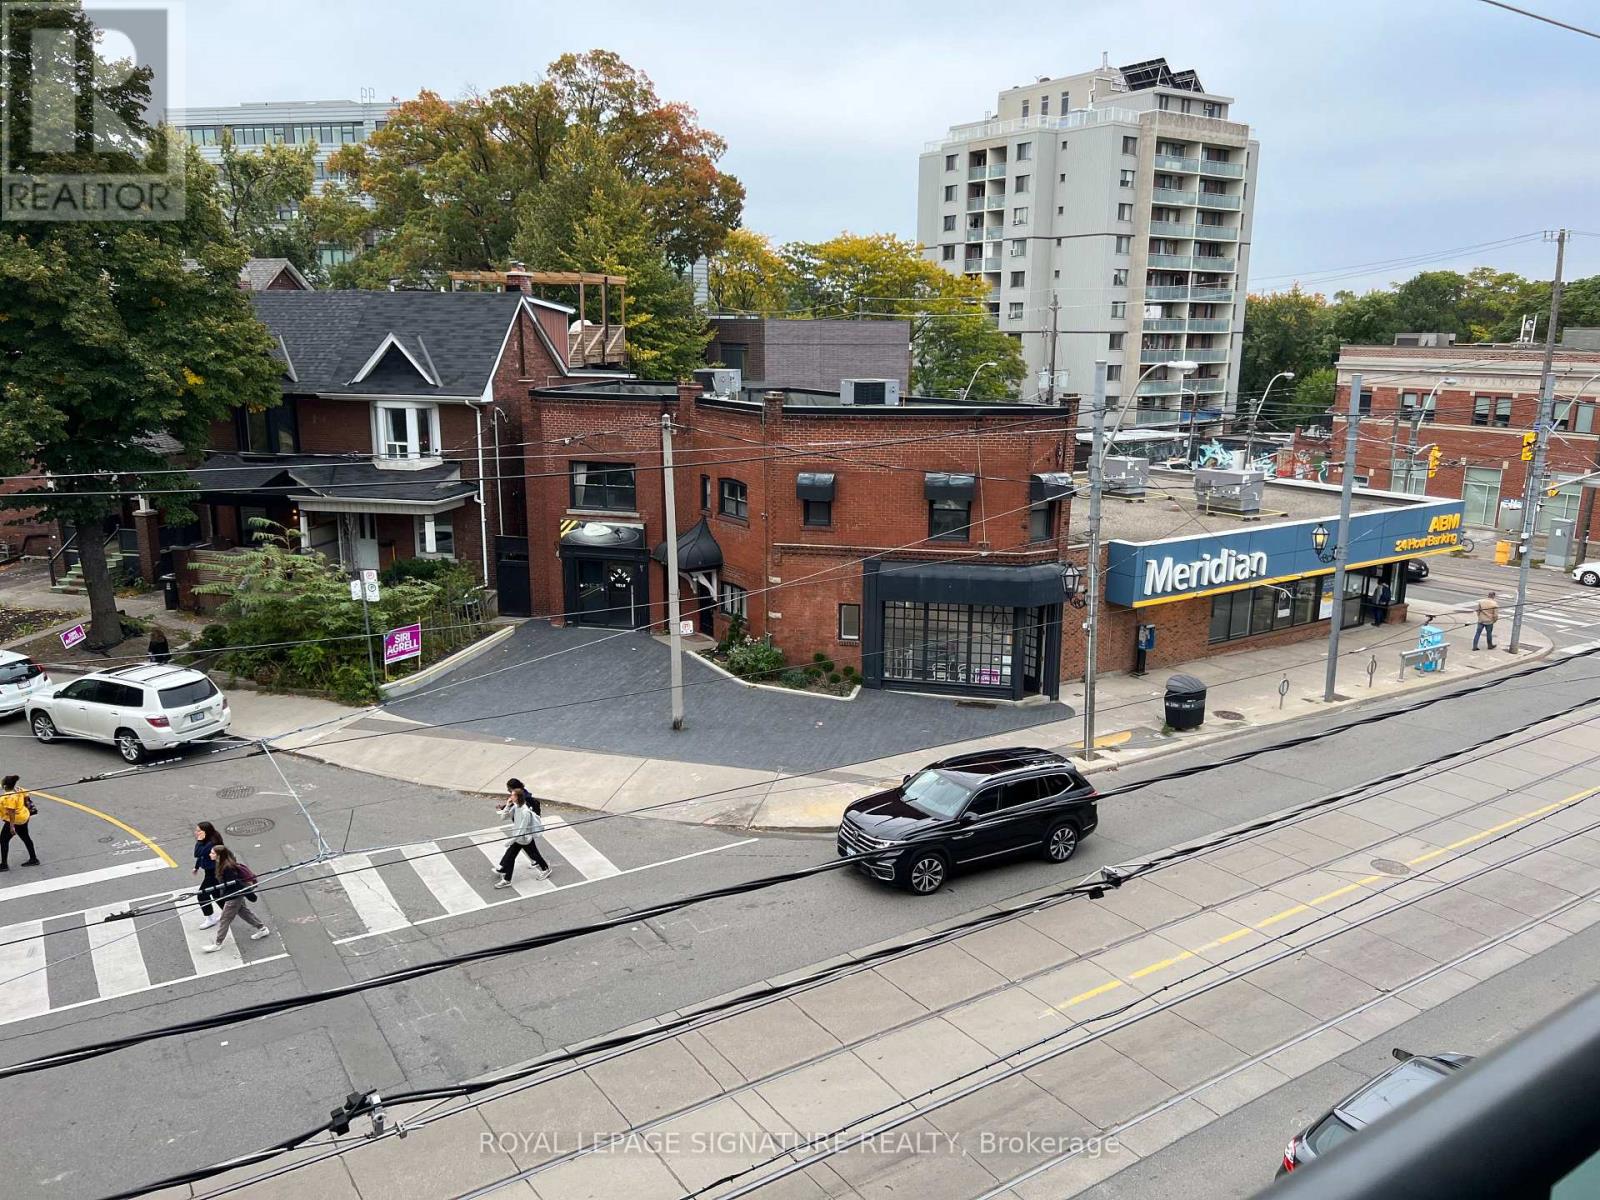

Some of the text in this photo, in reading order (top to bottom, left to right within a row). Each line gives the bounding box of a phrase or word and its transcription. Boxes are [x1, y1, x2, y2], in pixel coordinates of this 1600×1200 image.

[1427, 512, 1461, 533] ABM
[1394, 533, 1458, 552] 24 Hour Banking
[1143, 547, 1268, 596] Meridian
[387, 638, 419, 655] AGRELL
[394, 632, 411, 643] SIRI
